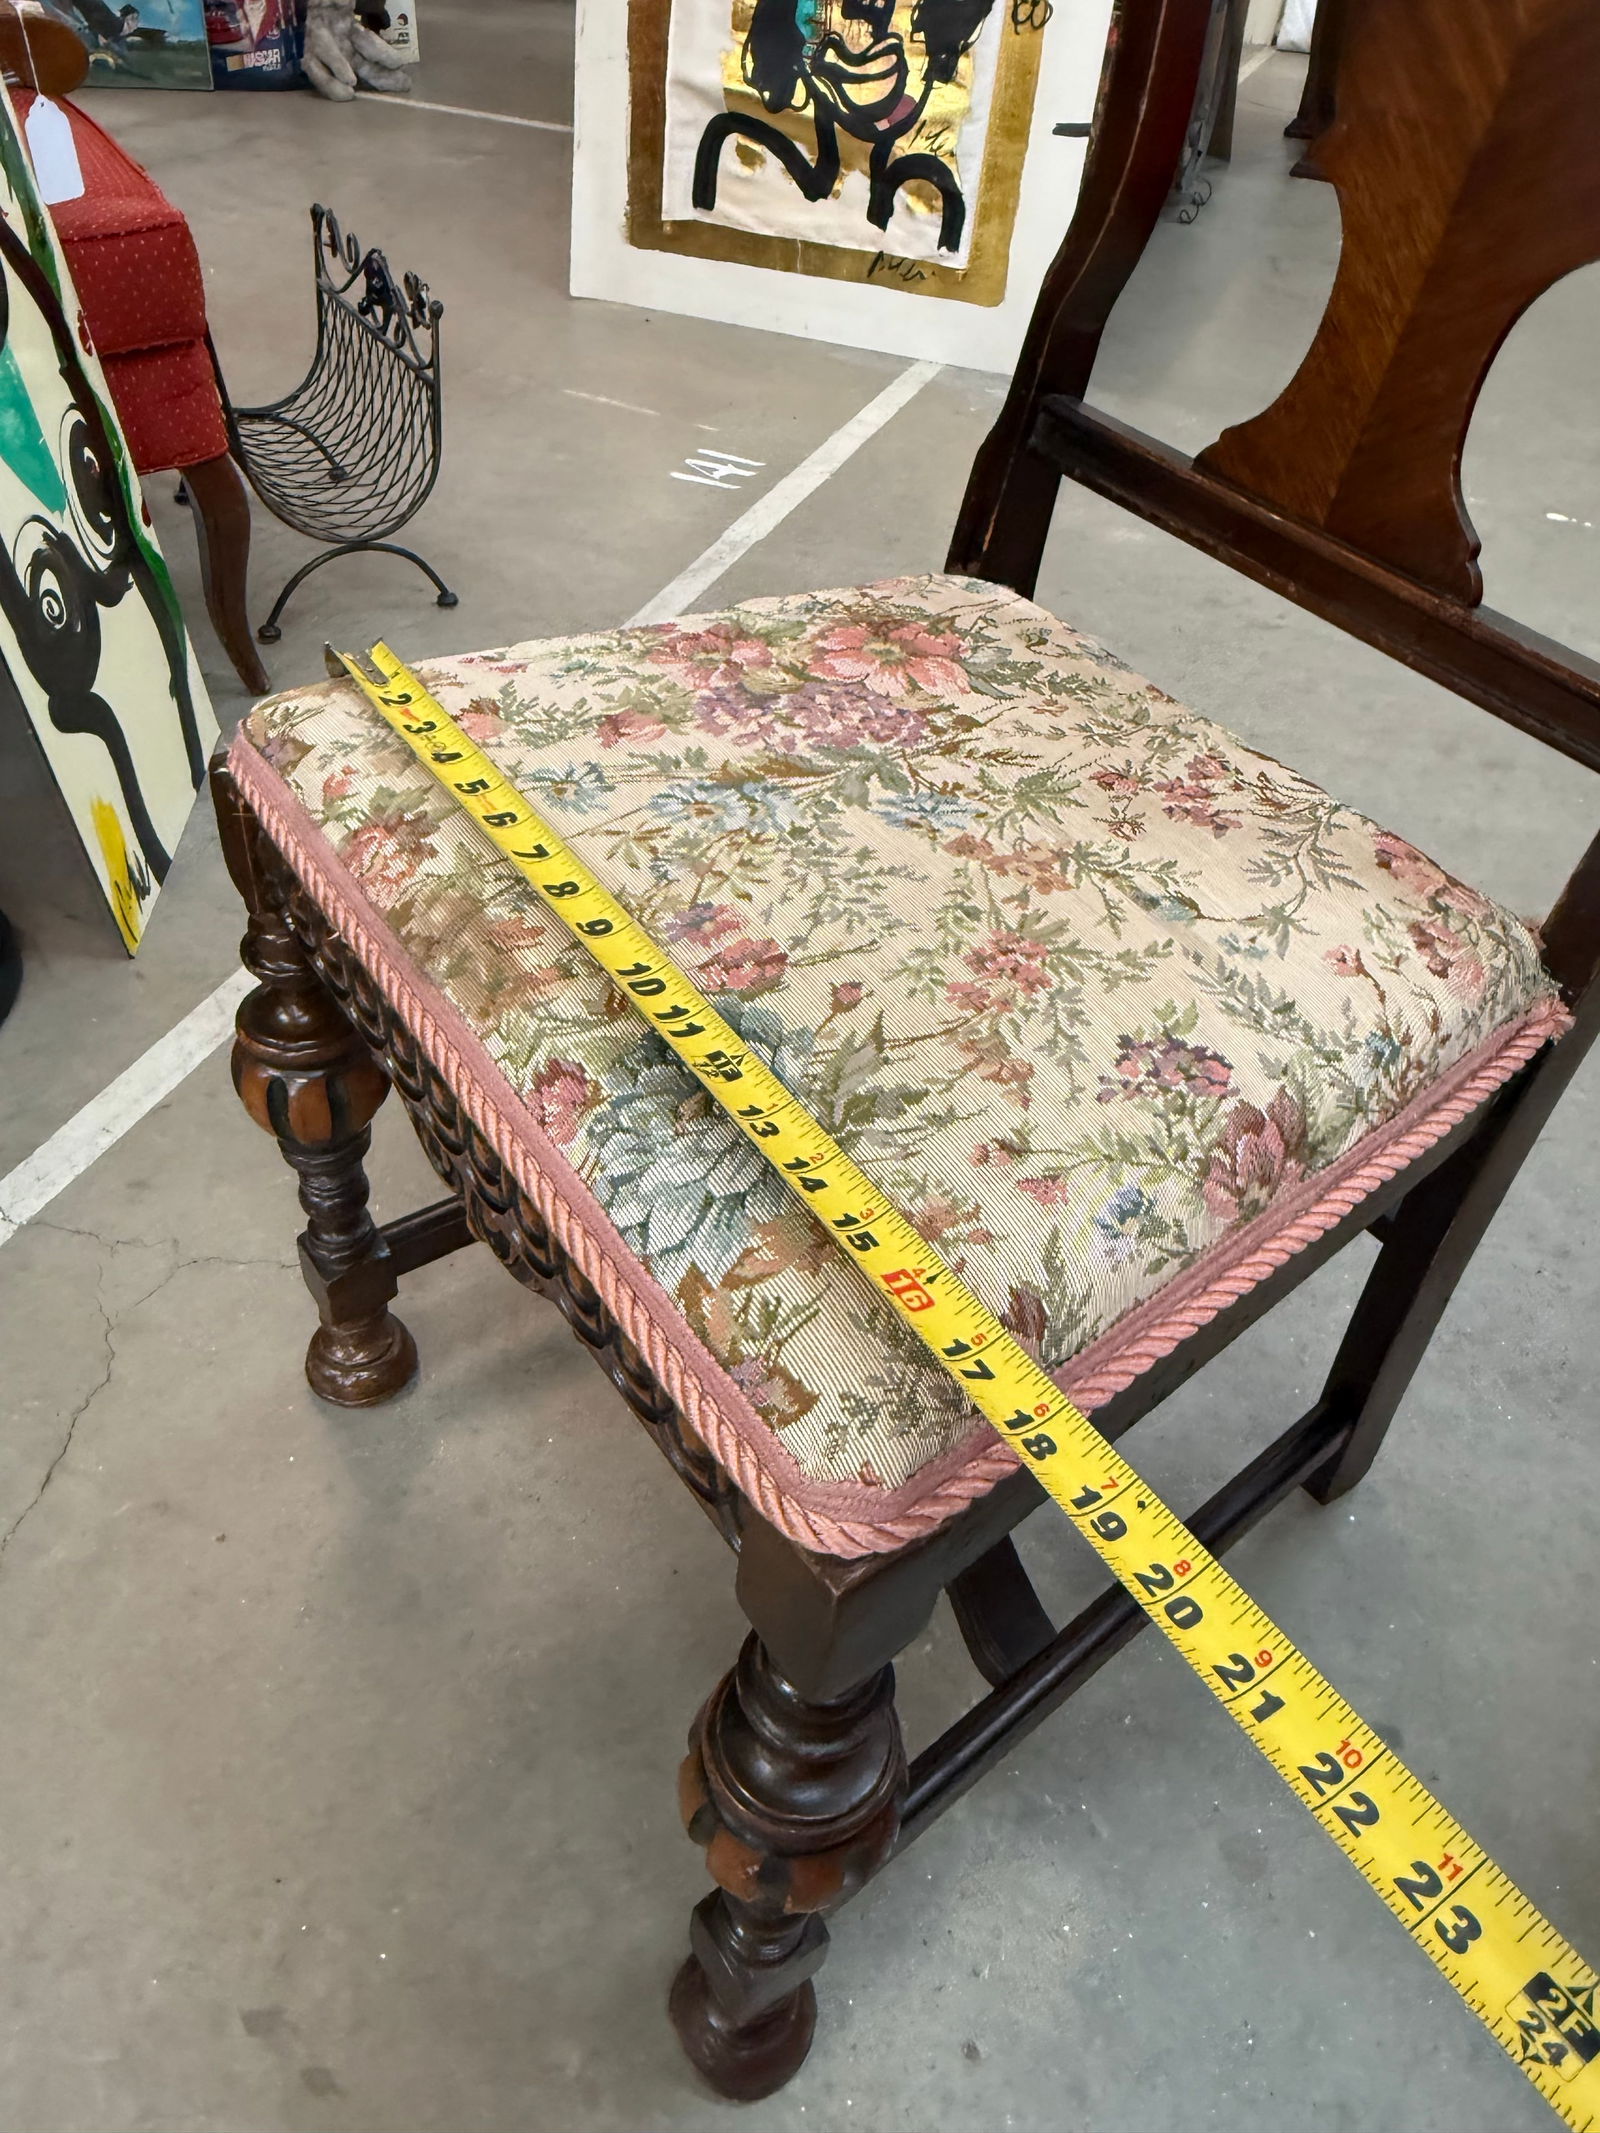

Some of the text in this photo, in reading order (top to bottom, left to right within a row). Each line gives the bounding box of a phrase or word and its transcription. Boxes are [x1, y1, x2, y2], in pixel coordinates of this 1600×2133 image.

[378, 693, 412, 706] 2
[402, 721, 437, 734] 3
[454, 779, 490, 794] 5
[482, 812, 517, 827] 6
[511, 844, 550, 859] 7
[543, 881, 579, 898] 8
[575, 918, 613, 936] 9
[615, 963, 667, 996] 10
[652, 1004, 707, 1037] 11
[736, 1104, 780, 1138] 13
[810, 1152, 825, 1164] 2
[782, 1157, 829, 1194] 14
[860, 1207, 874, 1220] 3
[832, 1213, 879, 1252] 15
[912, 1268, 926, 1279] 4
[889, 1273, 929, 1309] 16
[971, 1333, 986, 1346] 5
[942, 1338, 995, 1382] 17
[1034, 1403, 1050, 1418] 6
[1003, 1409, 1057, 1461] 18
[1101, 1477, 1119, 1490] 7
[1070, 1485, 1128, 1541] 19
[1173, 1560, 1191, 1576] 8
[1132, 1563, 1203, 1631] 20
[1254, 1649, 1272, 1669] 9
[1213, 1653, 1286, 1723] 21
[1336, 1740, 1363, 1769] 10
[1299, 1751, 1379, 1837] 22
[1437, 1853, 1464, 1881] 11
[1393, 1861, 1482, 1954] 23
[1516, 2005, 1569, 2068] 24
